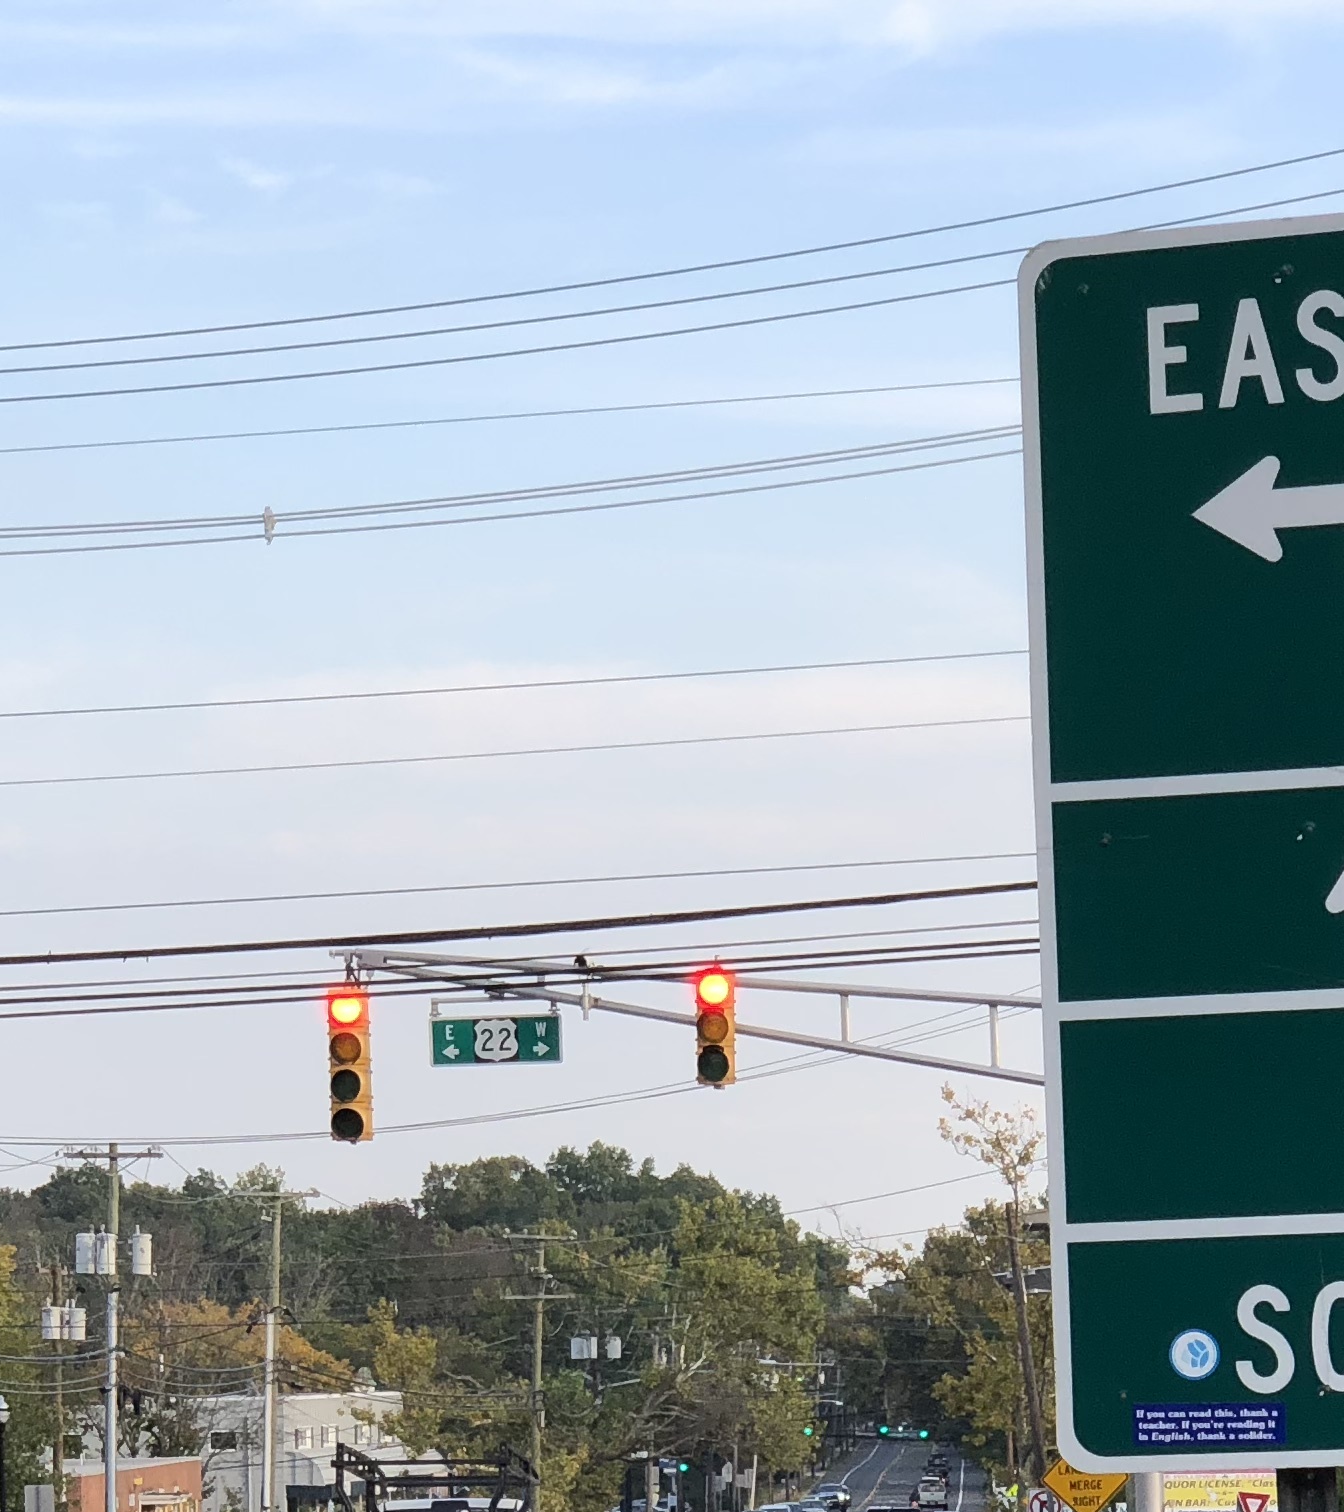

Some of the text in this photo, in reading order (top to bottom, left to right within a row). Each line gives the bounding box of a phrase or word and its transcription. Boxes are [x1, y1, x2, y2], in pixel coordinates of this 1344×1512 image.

[445, 1025, 454, 1040] E
[535, 1022, 547, 1037] W
[480, 1028, 512, 1052] 22
[1136, 1410, 1144, 1418] If
[1147, 1411, 1165, 1419] you
[1189, 1409, 1211, 1417] read
[1214, 1408, 1237, 1418] this,
[1240, 1408, 1268, 1417] thank
[1139, 1419, 1276, 1430] teacher. If you're reading it
[1138, 1432, 1148, 1441] in
[1152, 1432, 1194, 1442] English,
[1197, 1432, 1226, 1440] thank
[1069, 1480, 1102, 1491] MERGE
[1164, 1481, 1197, 1489] QUOR
